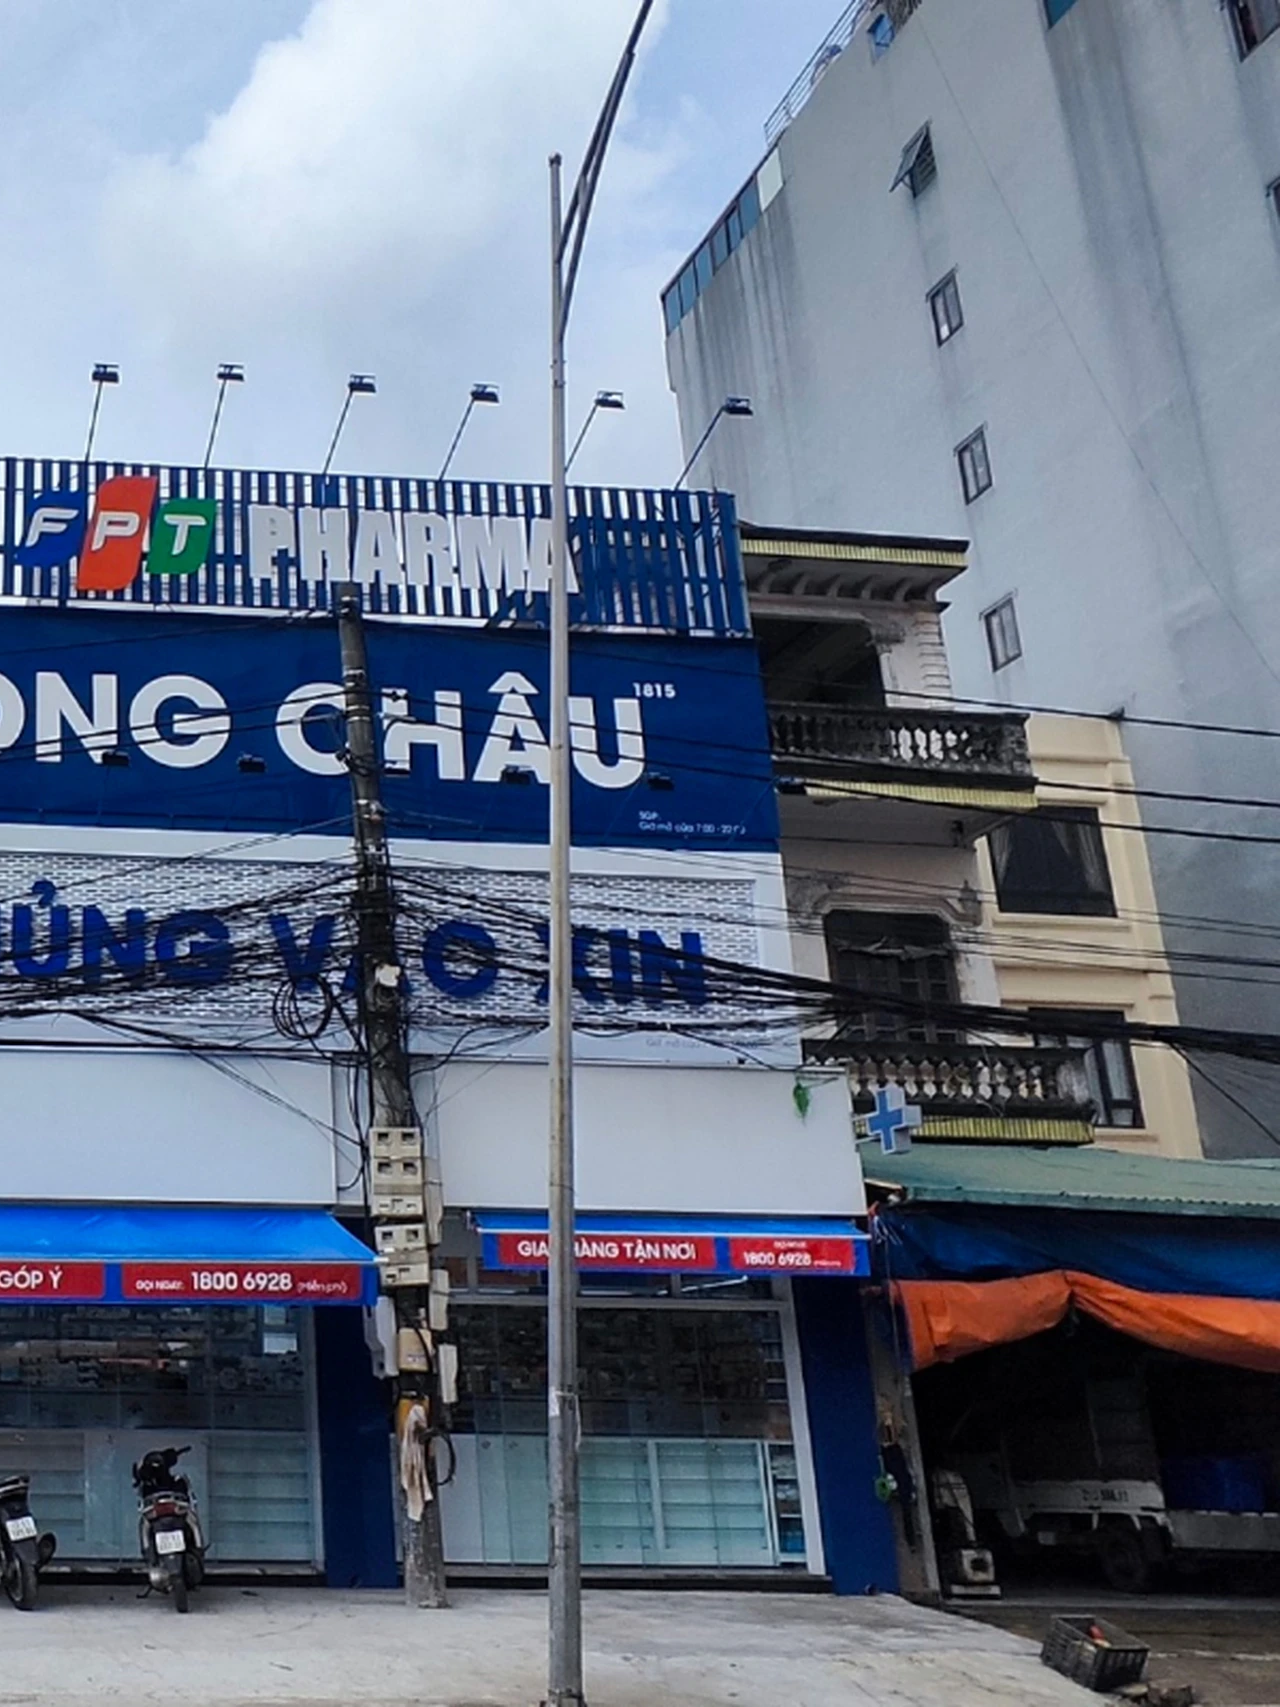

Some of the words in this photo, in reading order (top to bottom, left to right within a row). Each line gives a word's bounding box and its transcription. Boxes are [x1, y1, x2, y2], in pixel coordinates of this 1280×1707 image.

[247, 503, 578, 593] PHARMA
[275, 671, 646, 790] CHÂU
[270, 912, 498, 999] VC
[517, 1241, 551, 1257] GIA
[574, 1238, 620, 1258] ÀNG
[623, 1239, 662, 1263] TẬN
[664, 1243, 696, 1260] NƠI
[743, 1251, 775, 1265] 1800
[778, 1252, 811, 1266] 6928
[49, 1266, 62, 1289] Ý
[191, 1271, 238, 1290] 1800
[243, 1272, 292, 1291] 6928
